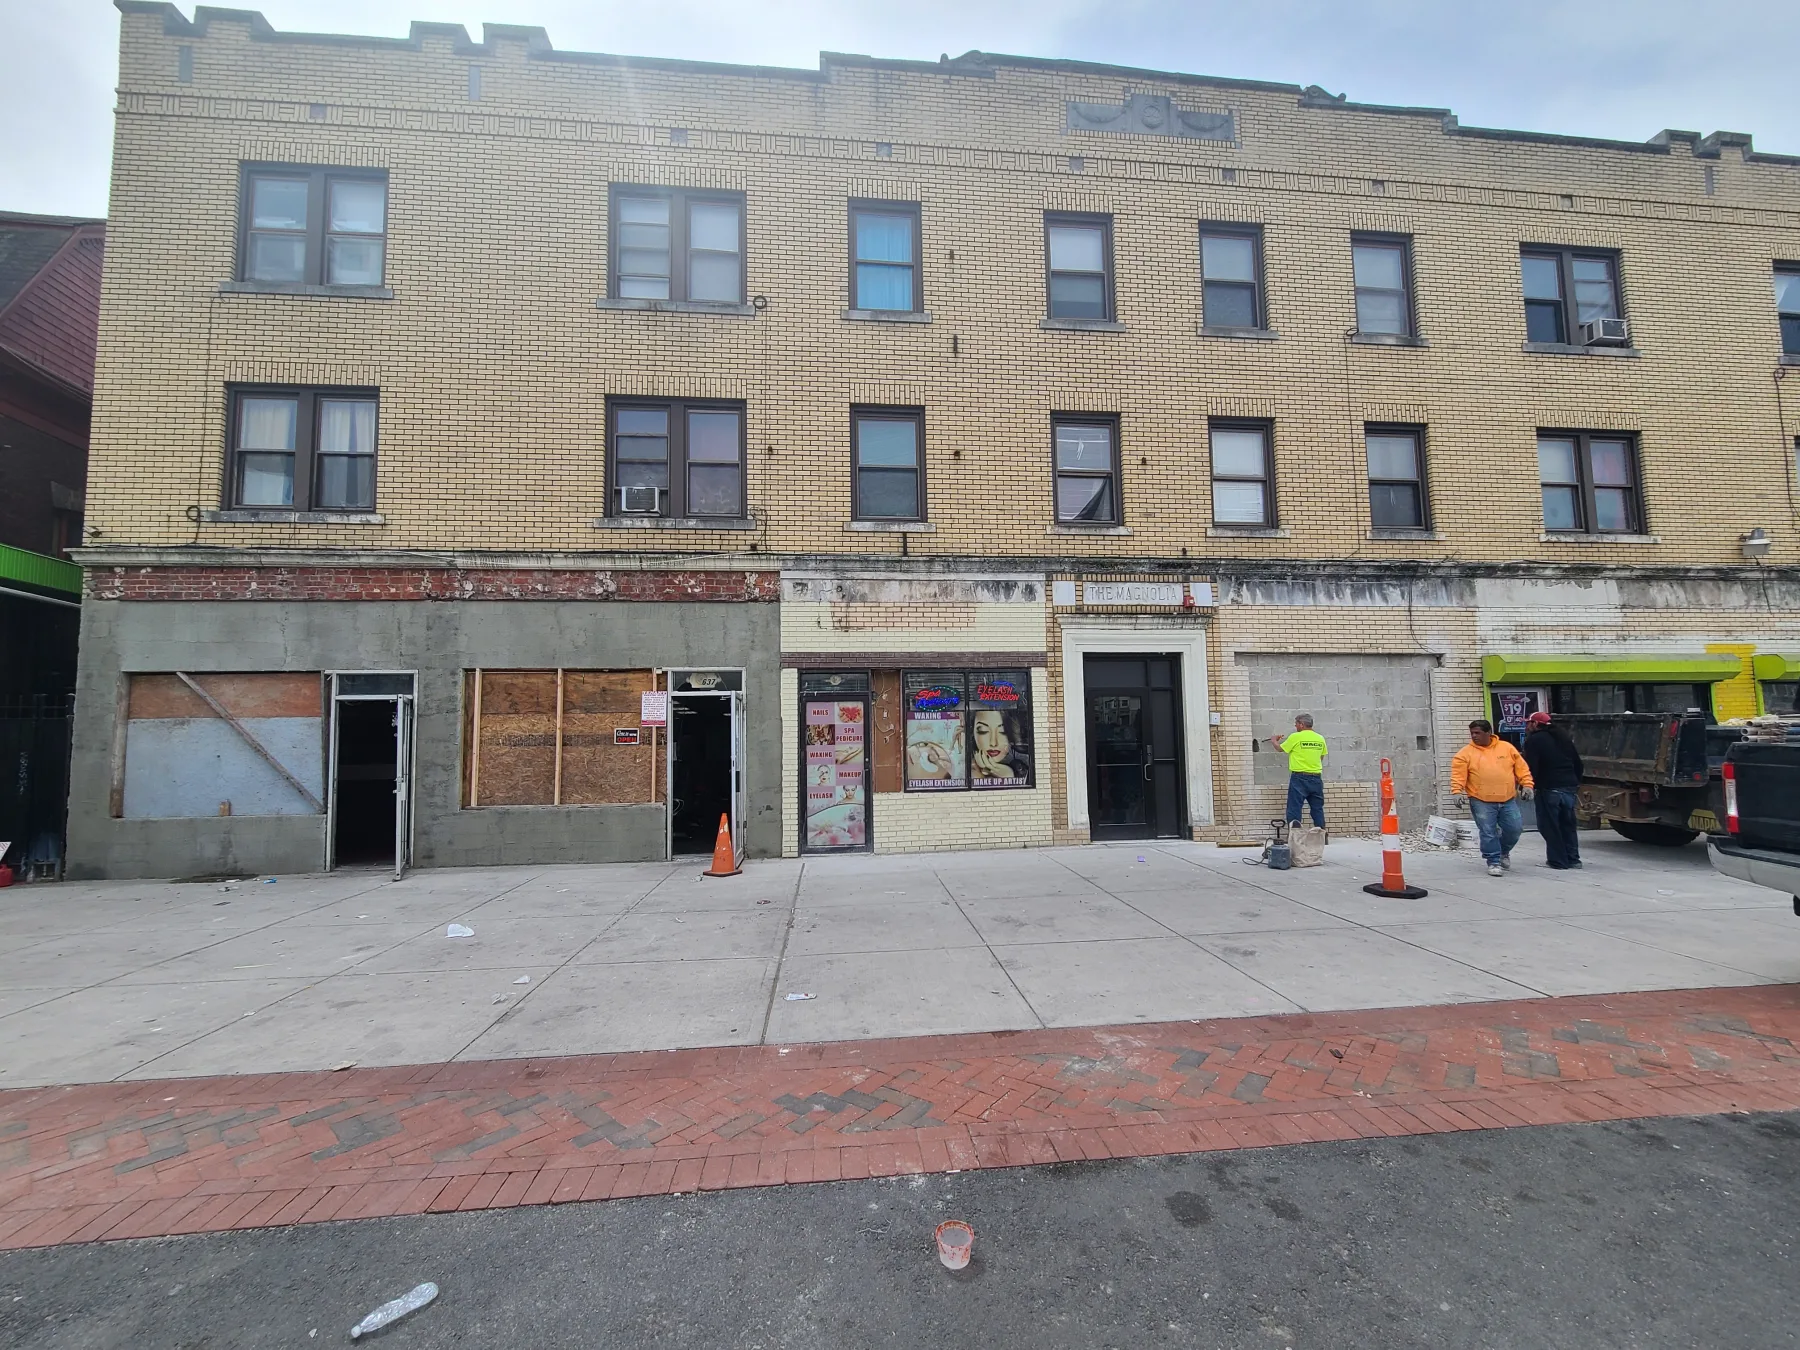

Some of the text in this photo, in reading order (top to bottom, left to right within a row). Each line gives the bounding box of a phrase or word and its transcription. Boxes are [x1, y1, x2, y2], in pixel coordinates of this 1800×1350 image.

[1089, 586, 1177, 601] THE MAGNOLIA
[977, 685, 1013, 694] EYELASH
[914, 689, 941, 700] Spa
[979, 693, 1020, 701] EXTENSION
[1503, 703, 1522, 715] $19
[914, 712, 942, 720] WAXING
[909, 779, 966, 788] EYELASH EXTENSION
[973, 778, 992, 786] MAKE
